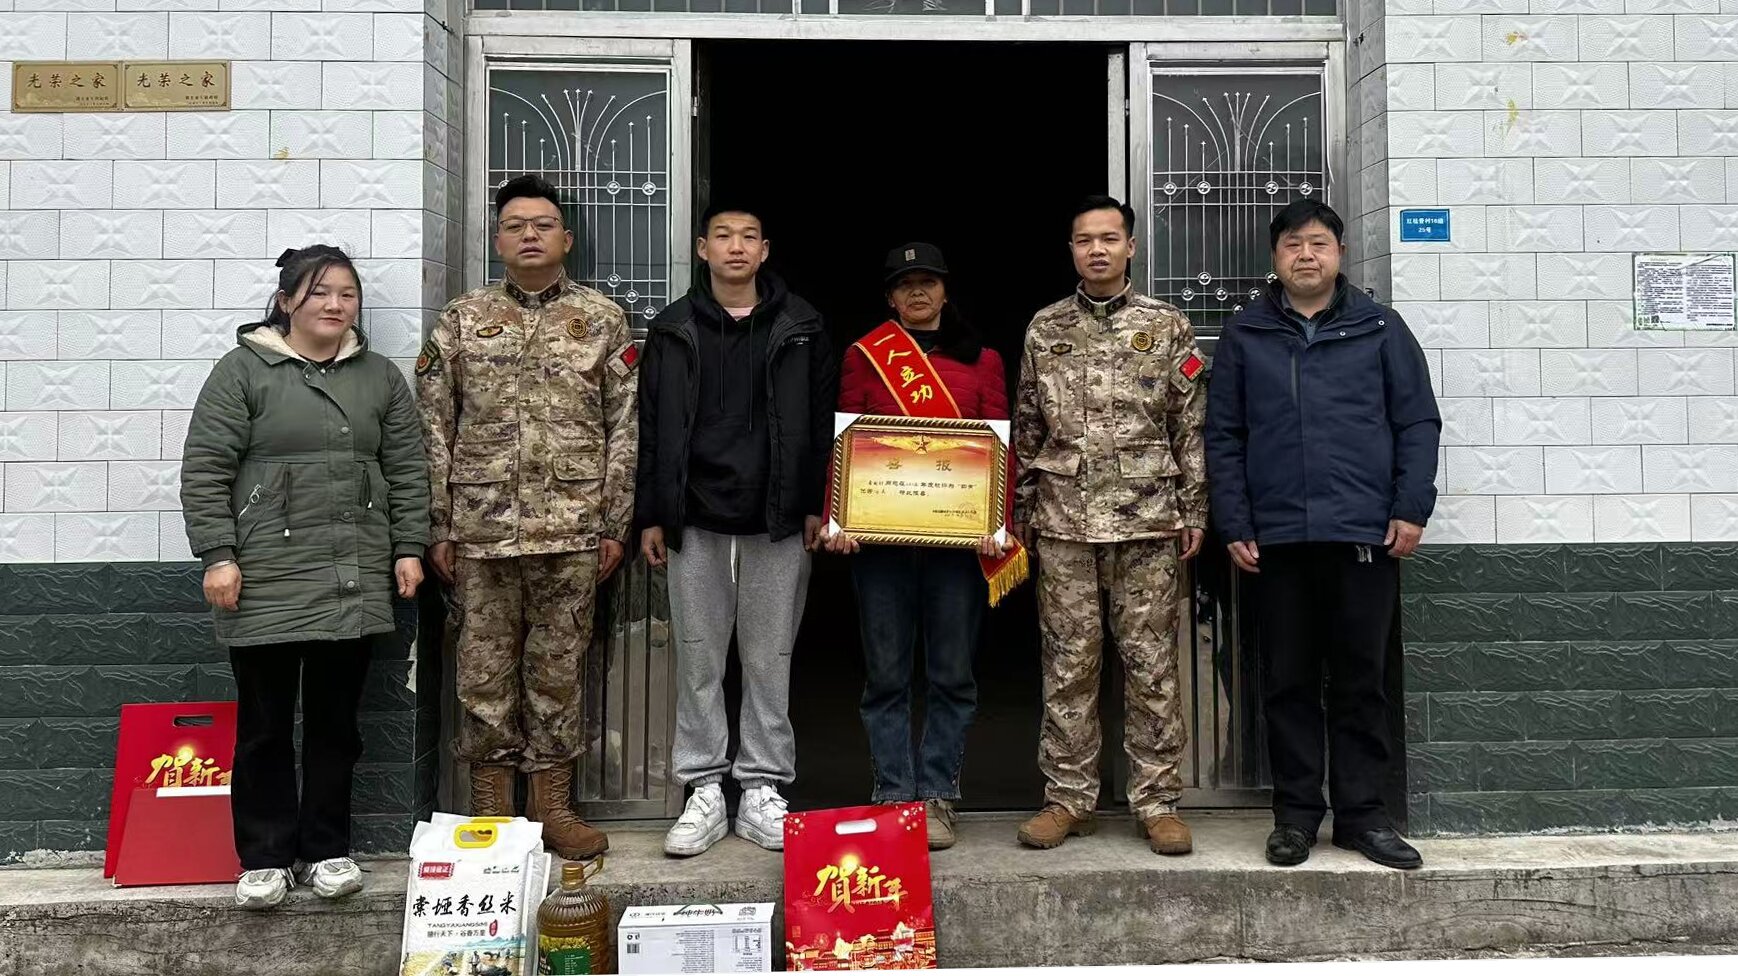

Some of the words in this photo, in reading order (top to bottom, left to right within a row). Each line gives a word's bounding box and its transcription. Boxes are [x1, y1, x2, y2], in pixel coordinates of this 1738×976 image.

[27, 72, 107, 88] 光荣之家
[137, 71, 215, 87] 光荣之家
[873, 333, 933, 404] 一人立功
[413, 891, 517, 918] 棠垭香丝米
